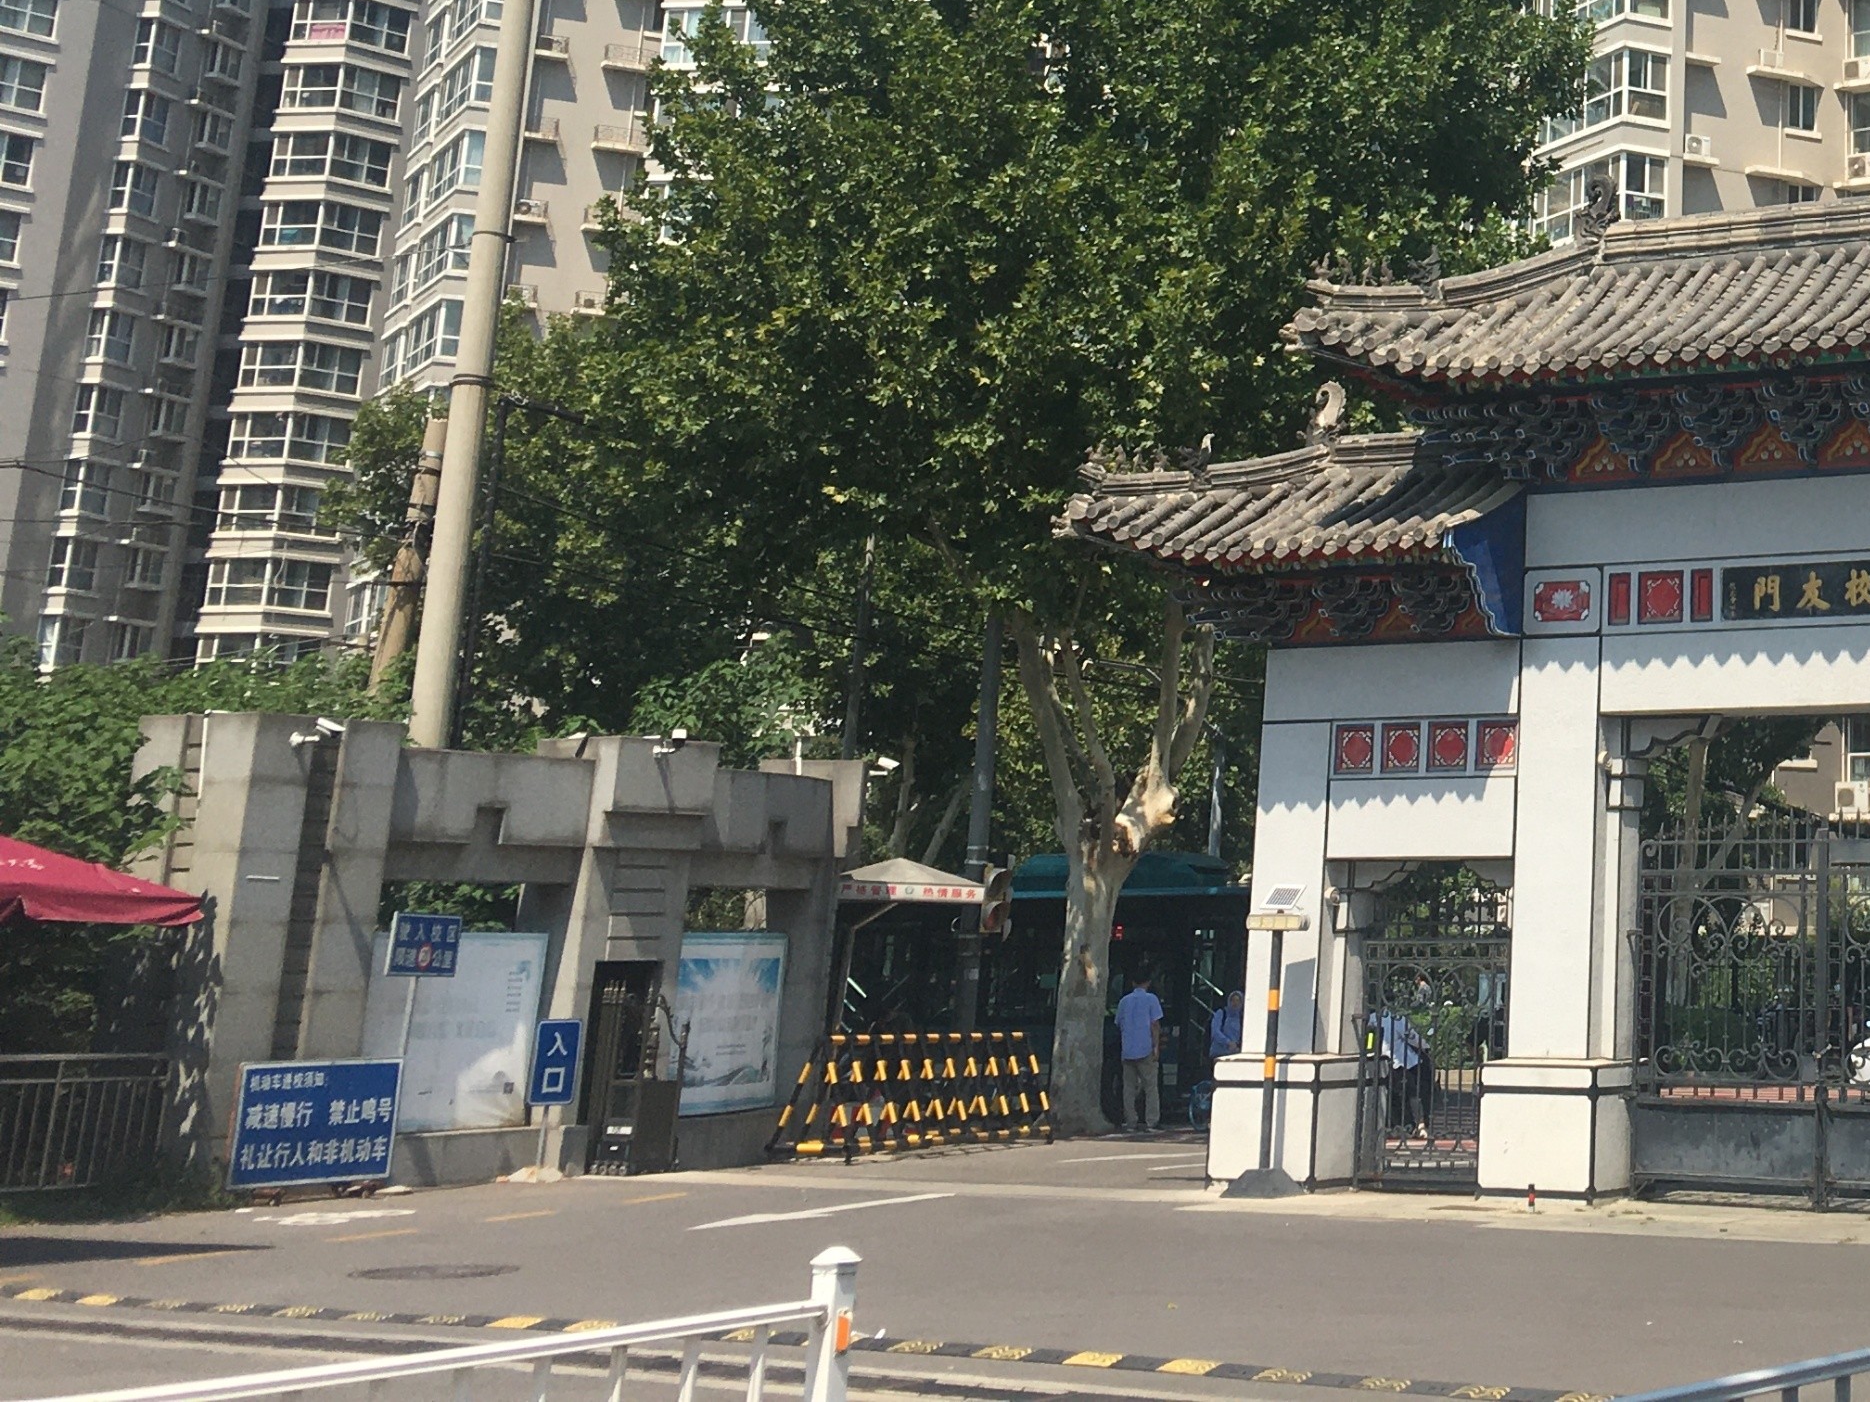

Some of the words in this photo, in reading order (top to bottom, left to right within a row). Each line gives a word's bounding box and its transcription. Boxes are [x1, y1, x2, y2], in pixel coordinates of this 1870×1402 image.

[922, 886, 977, 899] 热情服务
[541, 1032, 568, 1094] 入口
[244, 1101, 314, 1130] 减速慢行
[328, 1097, 393, 1126] 禁止鸣号
[240, 1135, 388, 1171] 礼让行人和非机动车
